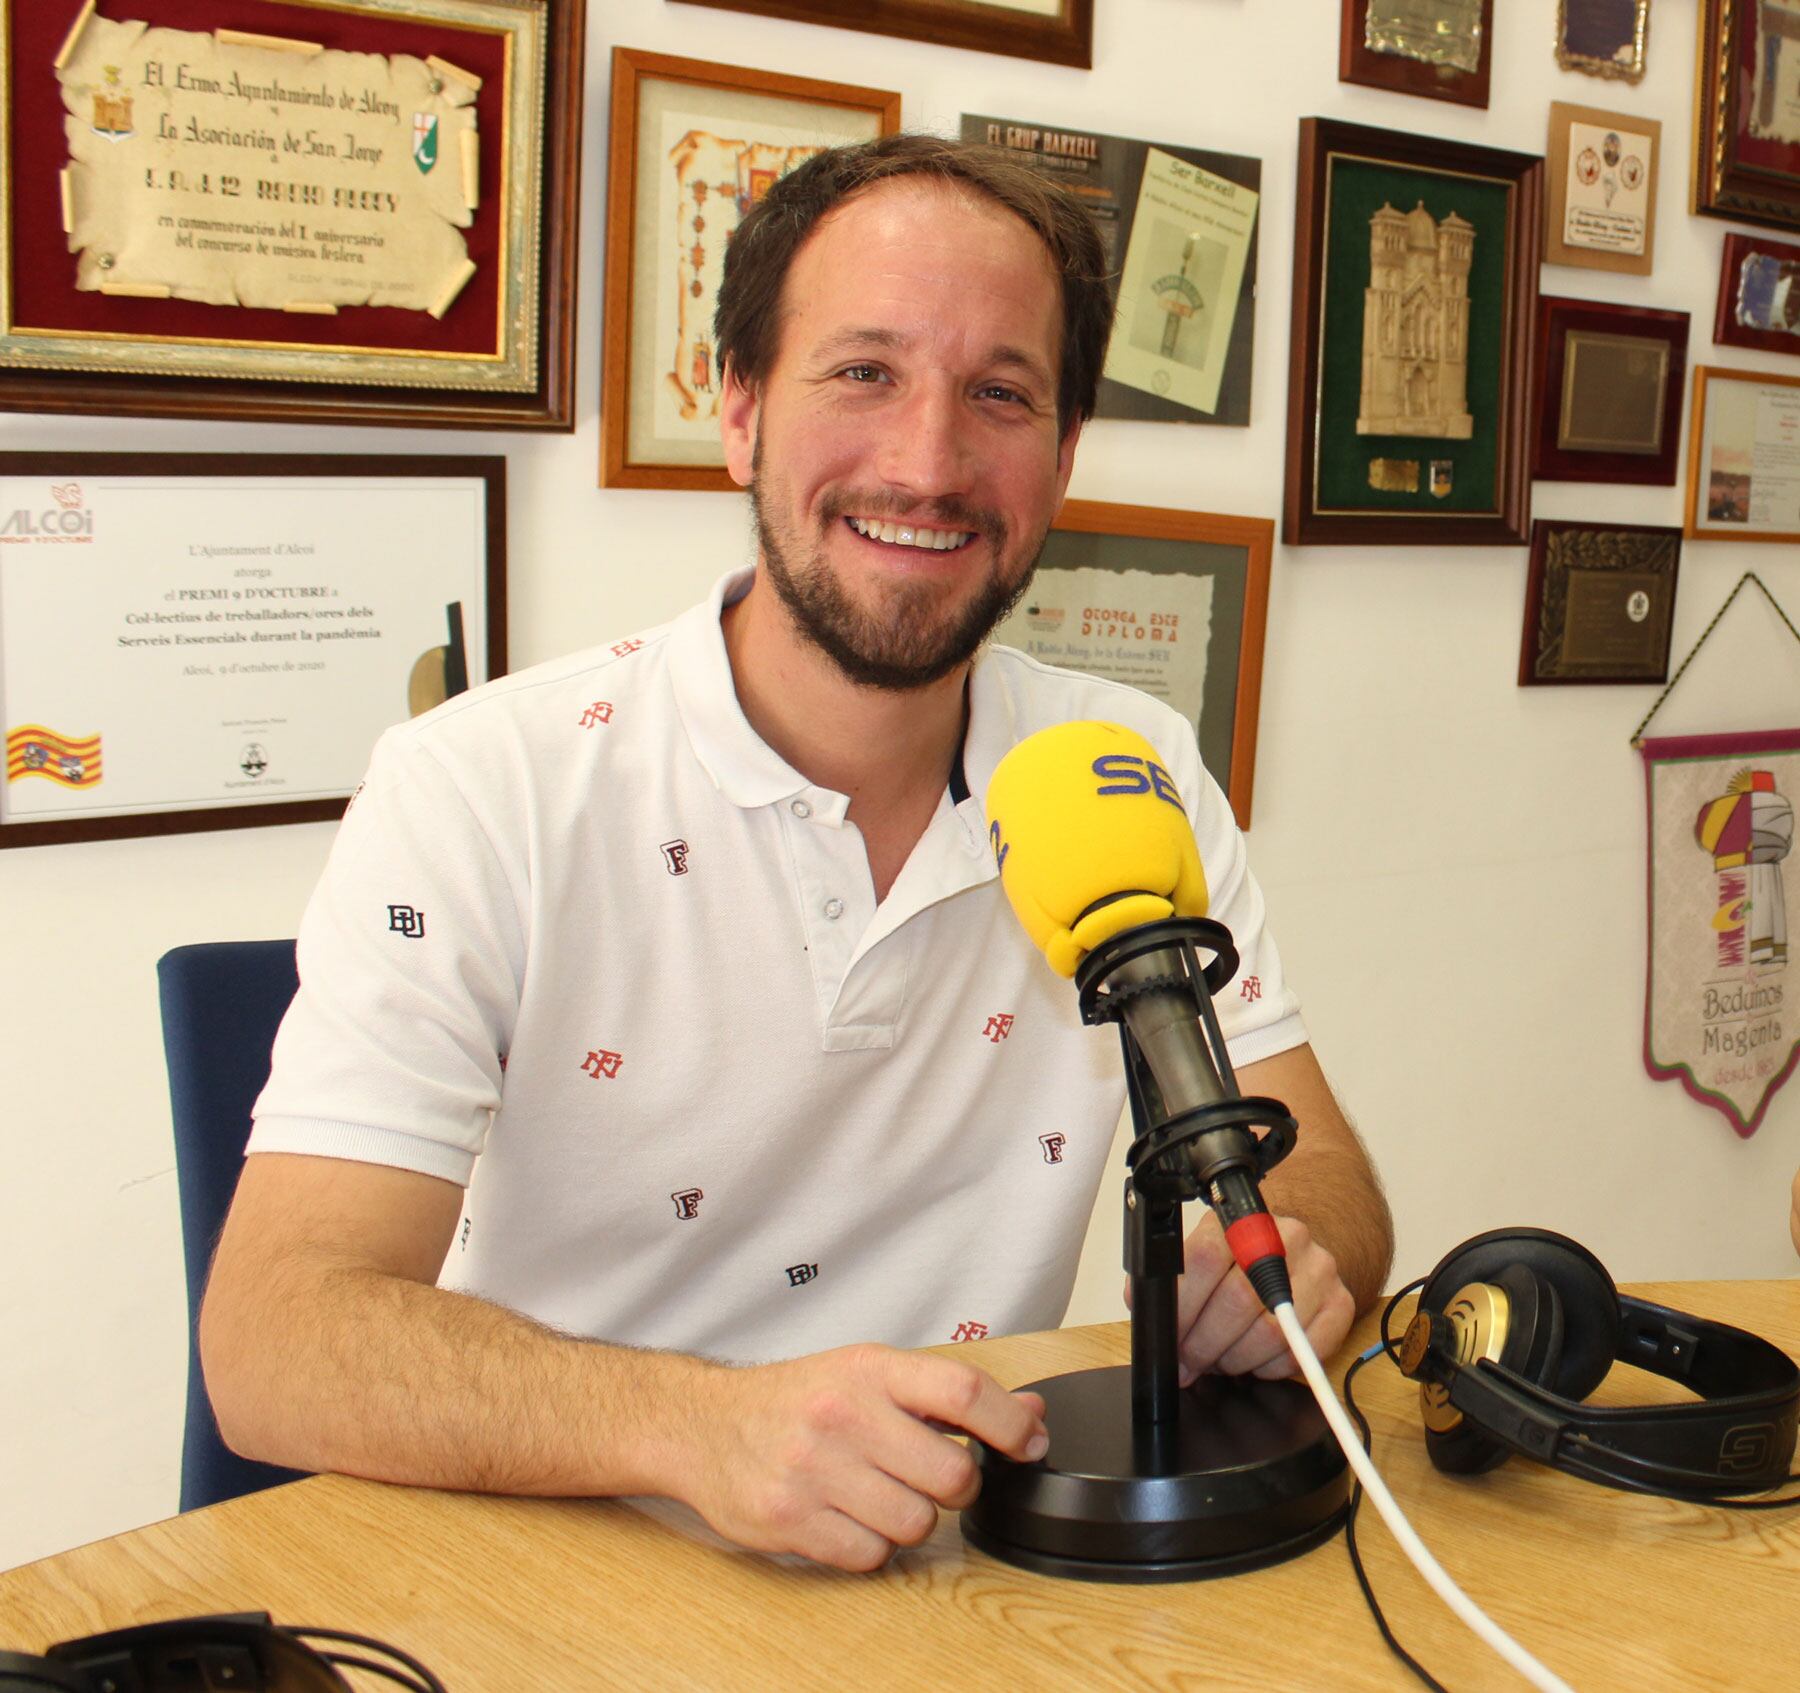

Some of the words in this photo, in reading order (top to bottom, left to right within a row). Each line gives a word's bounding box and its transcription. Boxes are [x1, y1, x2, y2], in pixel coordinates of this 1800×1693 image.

[144, 61, 164, 86] El
[226, 71, 335, 107] Ayuntamiento
[338, 89, 355, 108] de
[357, 89, 400, 124] Alcoy
[157, 113, 178, 140] La
[183, 115, 276, 151] Asociación
[283, 129, 300, 152] de
[304, 130, 336, 158] San
[342, 134, 383, 166] Jorge
[1169, 160, 1191, 179] Ser
[1194, 170, 1235, 198] Barxell
[157, 214, 175, 228] en
[278, 220, 296, 239] del
[314, 230, 385, 248] aniversario
[175, 232, 193, 248] del
[197, 237, 251, 254] concurso
[256, 240, 268, 256] de
[321, 243, 364, 264] festera
[189, 544, 271, 557] L'Ajuntament
[274, 543, 315, 555] d'Alcoi
[233, 566, 272, 579] atorga
[179, 589, 229, 601] PREMI
[245, 586, 329, 599] D'OCTUBRE
[206, 610, 222, 622] de
[347, 606, 373, 618] dels
[117, 635, 171, 647] Serveis
[175, 631, 247, 645] Essencials
[250, 630, 297, 642] durant
[300, 629, 312, 640] la
[316, 627, 382, 643] pandèmia
[230, 662, 279, 674] d'octubre
[281, 661, 295, 671] de
[297, 660, 326, 671] 2020
[660, 839, 689, 876] F
[1703, 984, 1783, 1019] Beduinos
[1703, 1020, 1781, 1057] Magenta
[1038, 1131, 1066, 1164] F
[671, 1187, 702, 1221] F
